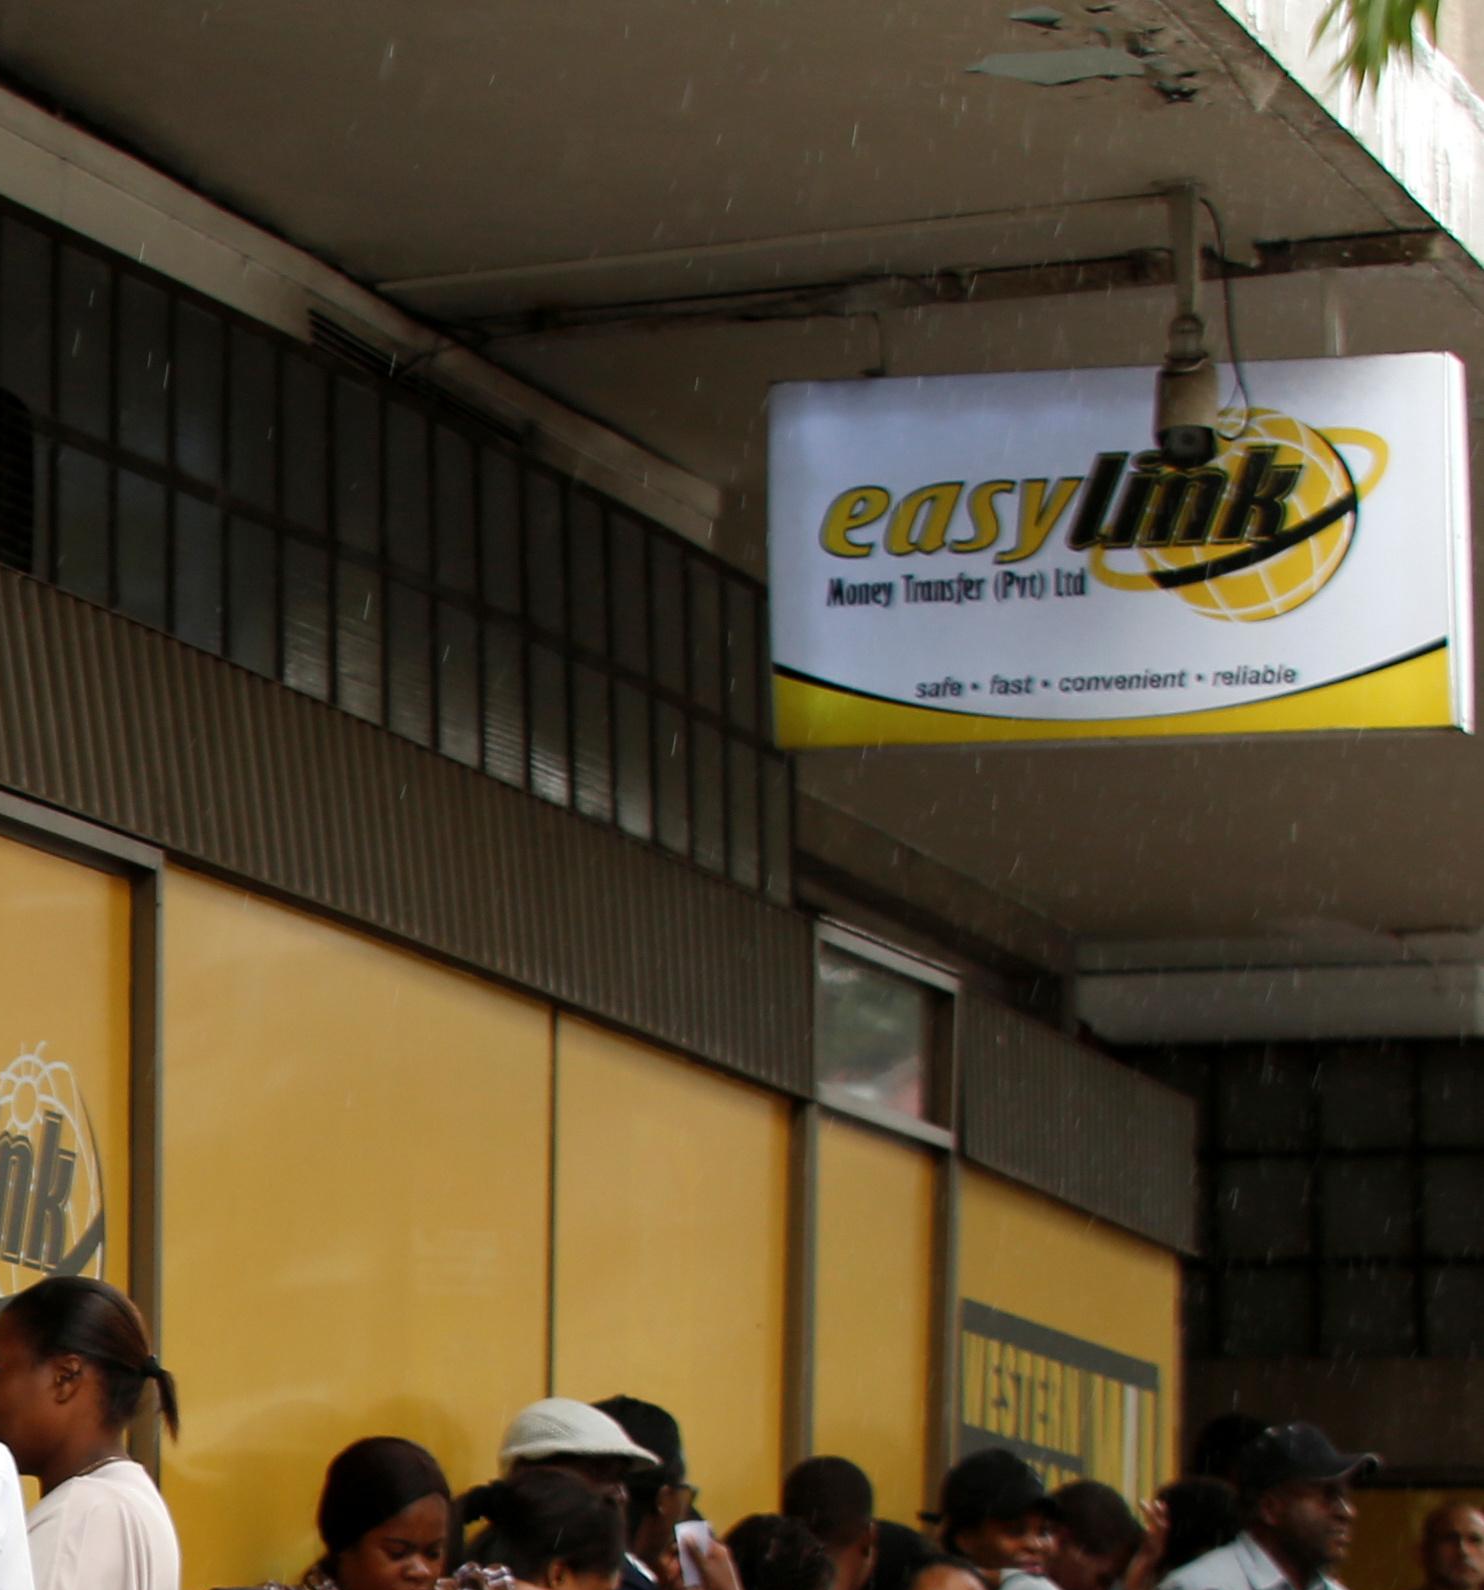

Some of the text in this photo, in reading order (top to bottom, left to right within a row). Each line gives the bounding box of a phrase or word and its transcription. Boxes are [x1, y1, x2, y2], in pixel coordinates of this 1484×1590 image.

[818, 444, 1303, 566] easylink
[827, 567, 1087, 607] Money Transfer (Pvt) Ltd
[914, 663, 1297, 698] safe fast convenient reliable
